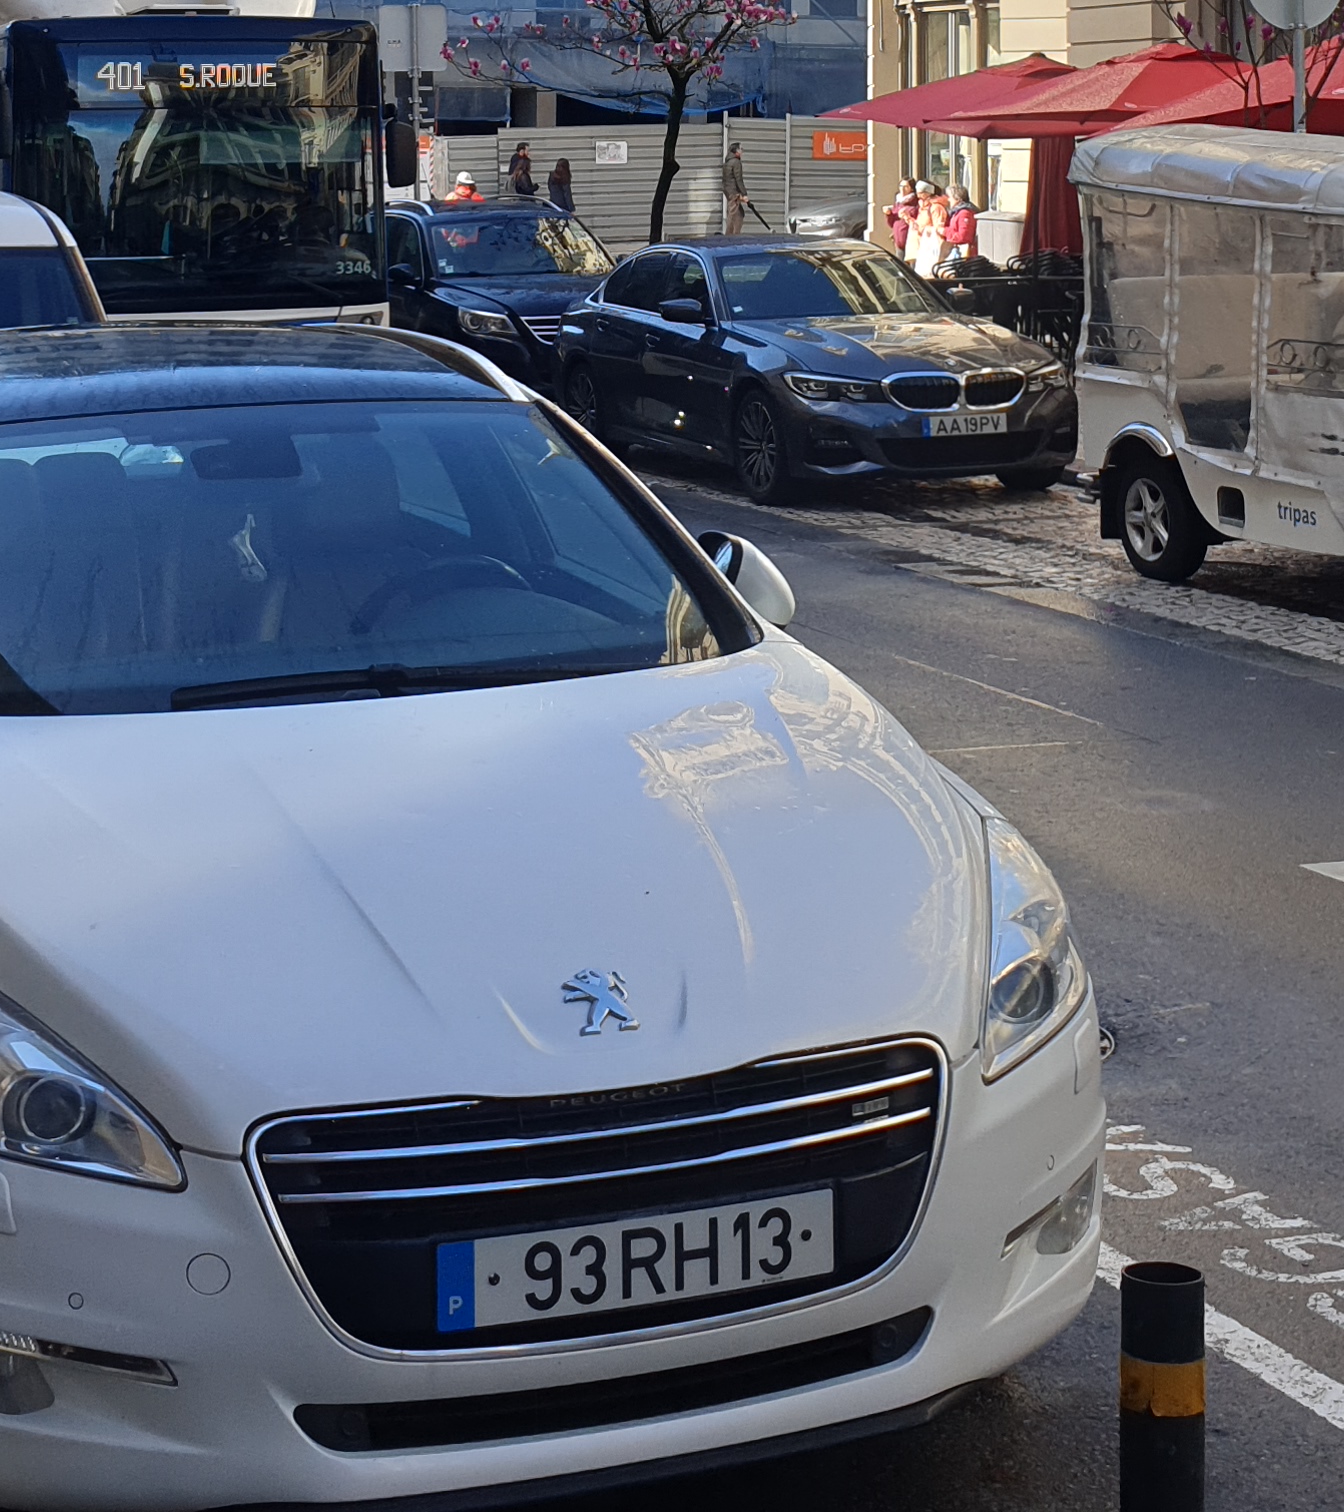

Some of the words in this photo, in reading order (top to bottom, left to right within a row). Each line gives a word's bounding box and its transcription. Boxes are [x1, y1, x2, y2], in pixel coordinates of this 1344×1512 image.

[97, 61, 146, 90] 401
[179, 63, 277, 90] S.ROQUE
[336, 260, 372, 275] 3346
[936, 416, 1001, 435] AA19PV
[1277, 501, 1317, 528] tripas
[550, 1083, 687, 1108] PEUGEOT
[524, 1206, 792, 1312] 93RH13
[448, 1295, 463, 1315] P
